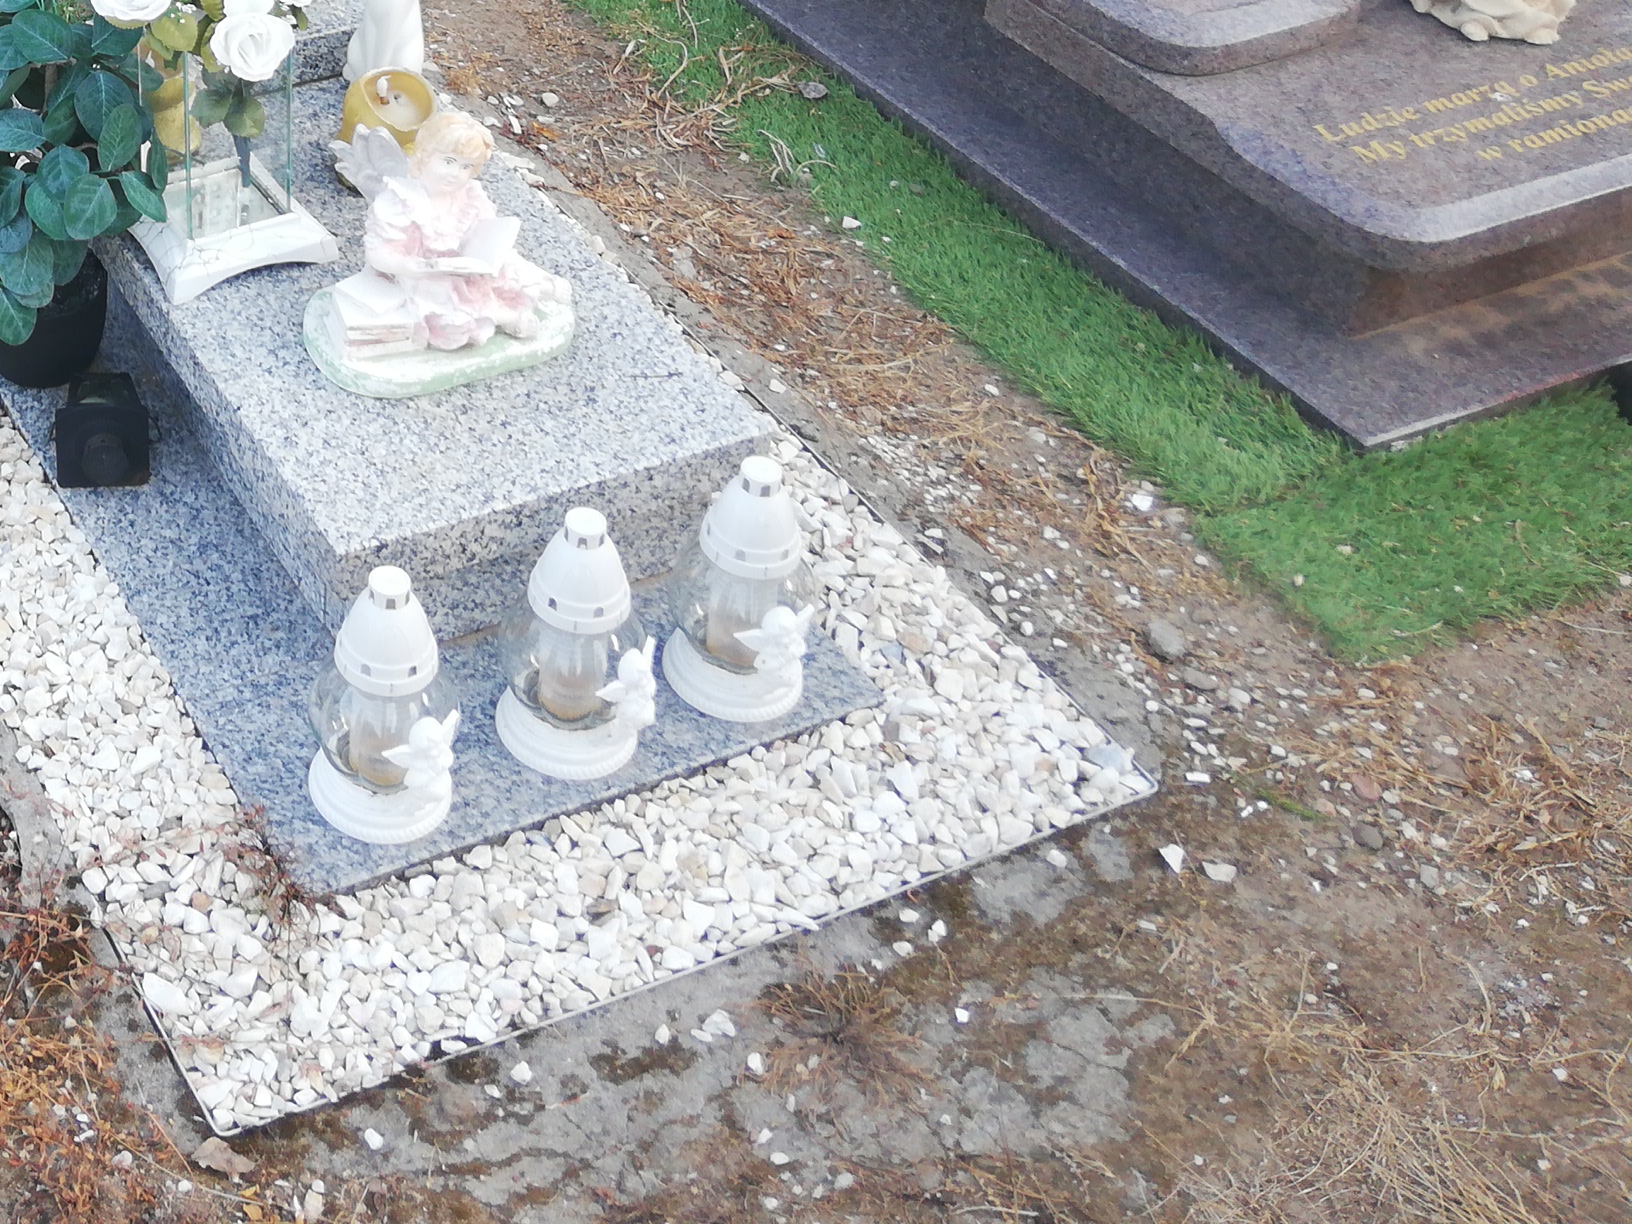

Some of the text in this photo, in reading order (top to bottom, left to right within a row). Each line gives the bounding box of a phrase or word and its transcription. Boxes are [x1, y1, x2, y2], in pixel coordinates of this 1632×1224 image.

[1312, 104, 1421, 143] Ludzie
[1519, 74, 1539, 88] o
[1349, 138, 1407, 166] My
[1408, 88, 1585, 145] trzymaliśmy
[1477, 143, 1504, 162] w
